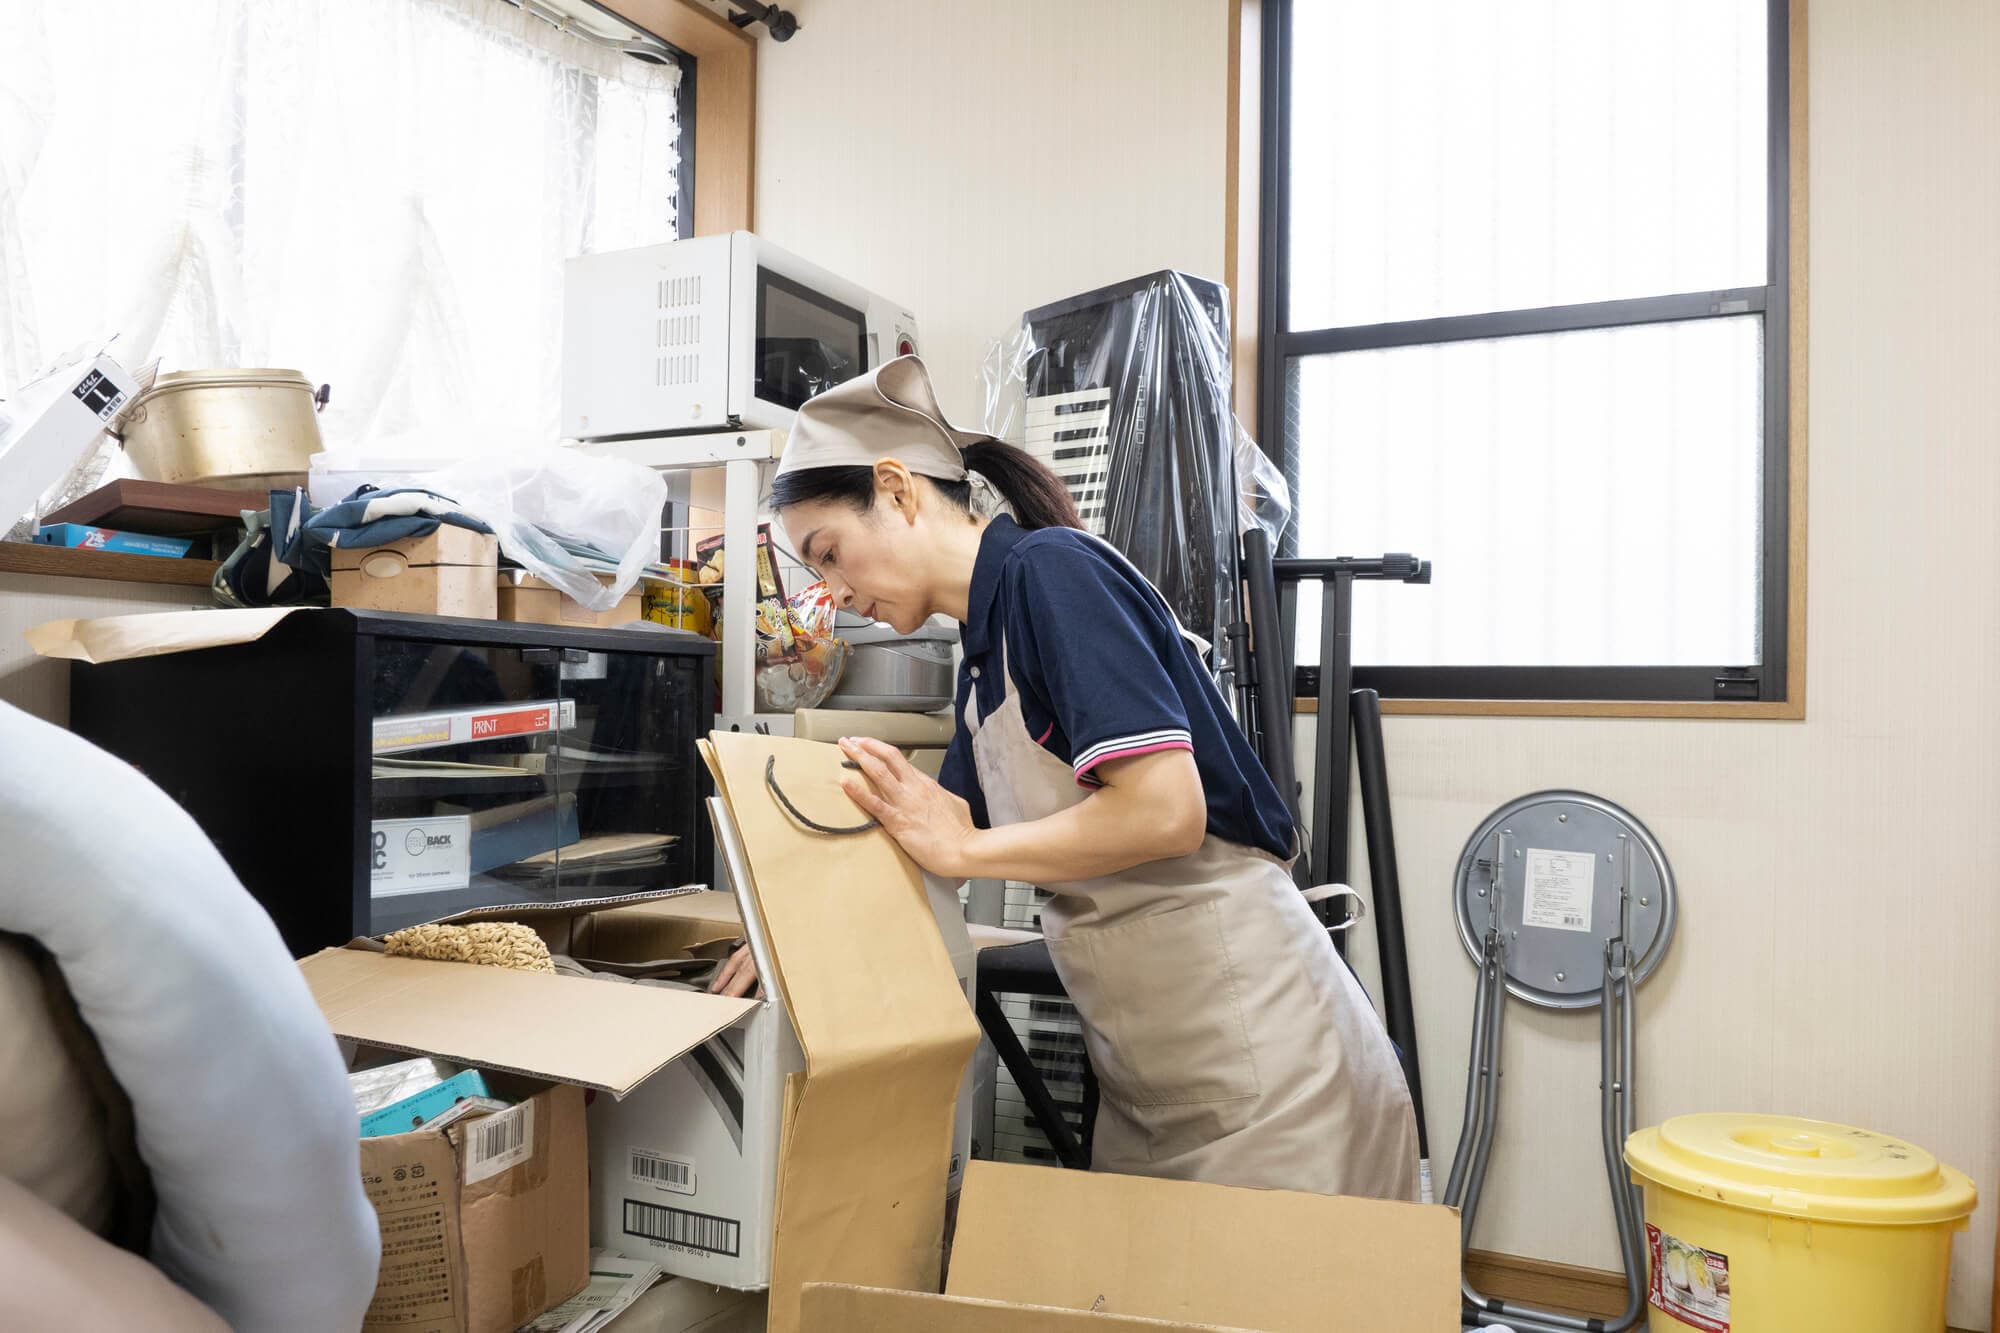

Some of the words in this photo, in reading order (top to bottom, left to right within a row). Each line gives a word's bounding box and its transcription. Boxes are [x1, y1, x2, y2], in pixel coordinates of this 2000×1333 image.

[78, 374, 98, 394] ブラック
[473, 719, 498, 735] PRINT
[426, 835, 451, 846] BACK
